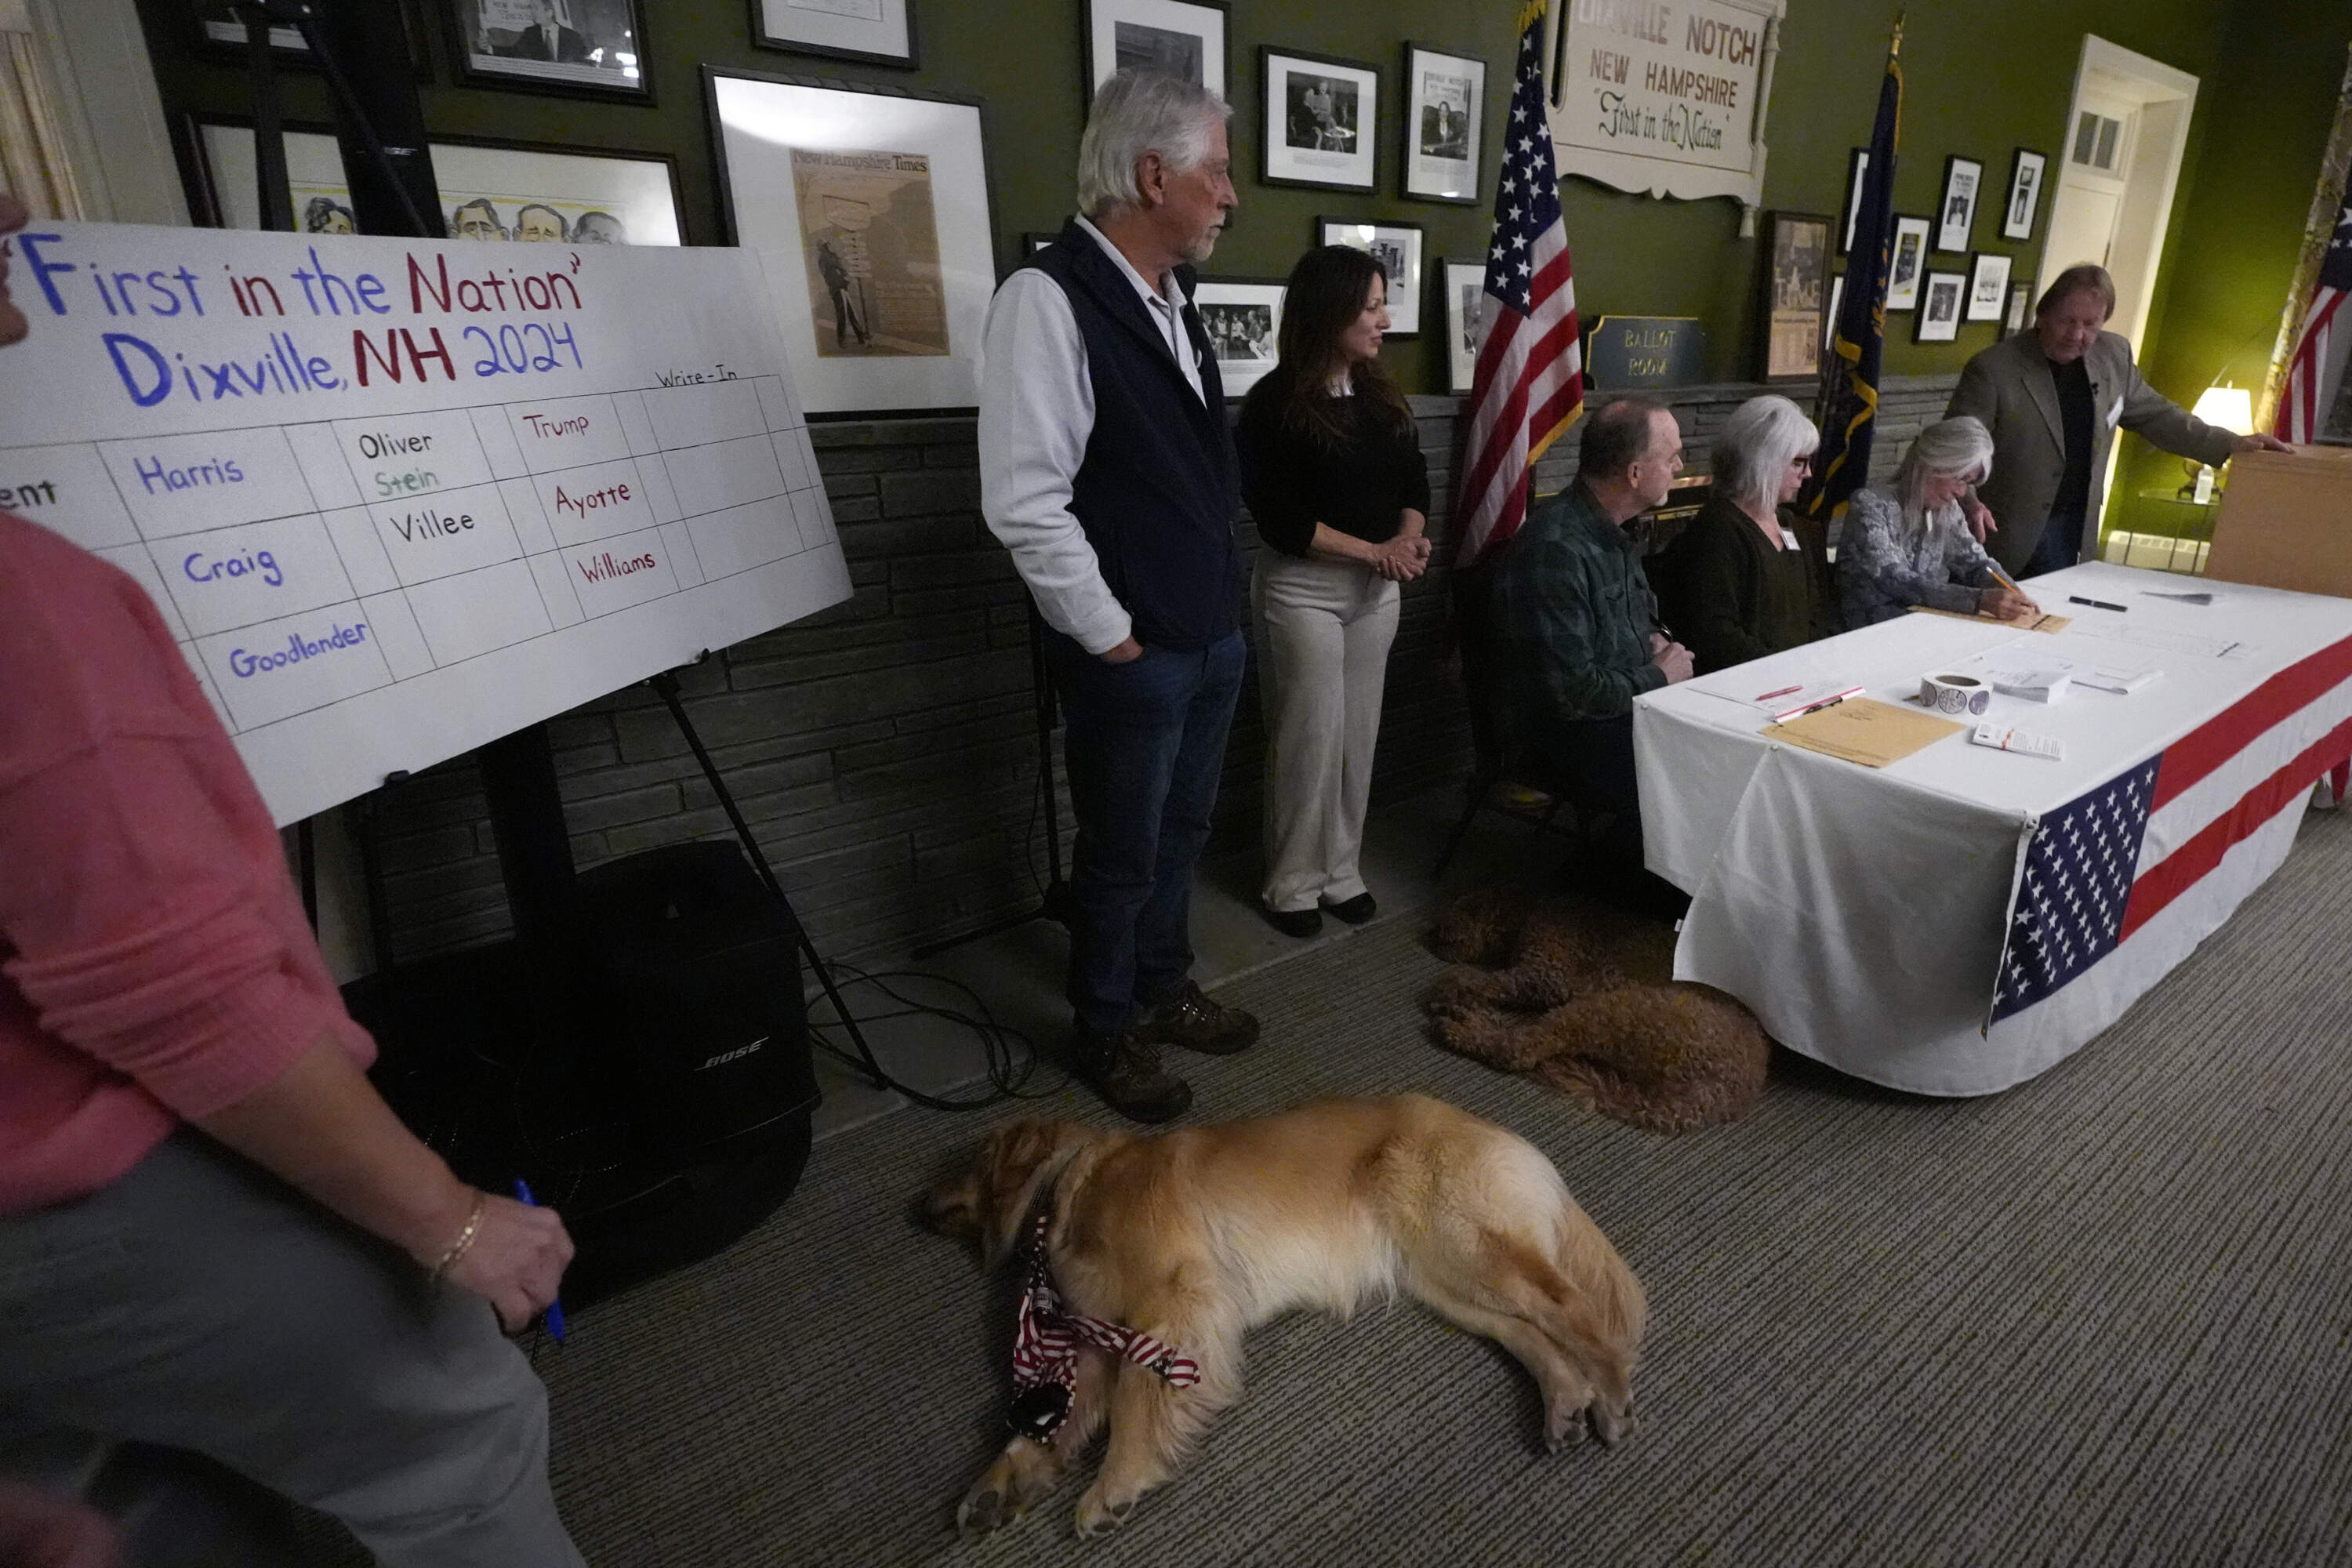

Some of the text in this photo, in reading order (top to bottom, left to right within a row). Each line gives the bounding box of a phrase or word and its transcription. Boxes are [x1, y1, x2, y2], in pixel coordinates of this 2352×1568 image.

[1686, 14, 1757, 67] NOTCH
[1590, 49, 1738, 108] NEW HAMPSHIRE
[1661, 103, 1680, 143] the
[891, 154, 927, 172] Times
[224, 264, 285, 316] in
[292, 246, 391, 315] the
[1624, 328, 1677, 348] BALLOT
[102, 321, 583, 408] Dixville, NH 2024
[656, 364, 739, 388] Write-In
[523, 413, 590, 440] Trump
[359, 433, 433, 459] Oliver
[134, 456, 245, 495] Harris
[375, 466, 440, 497] Stein
[556, 484, 632, 519] Ayotte
[390, 510, 476, 543] Villee
[183, 549, 284, 586] Craig
[576, 551, 656, 584] Williams
[230, 623, 367, 678] Goodlander
[694, 1036, 769, 1072] BOSE
